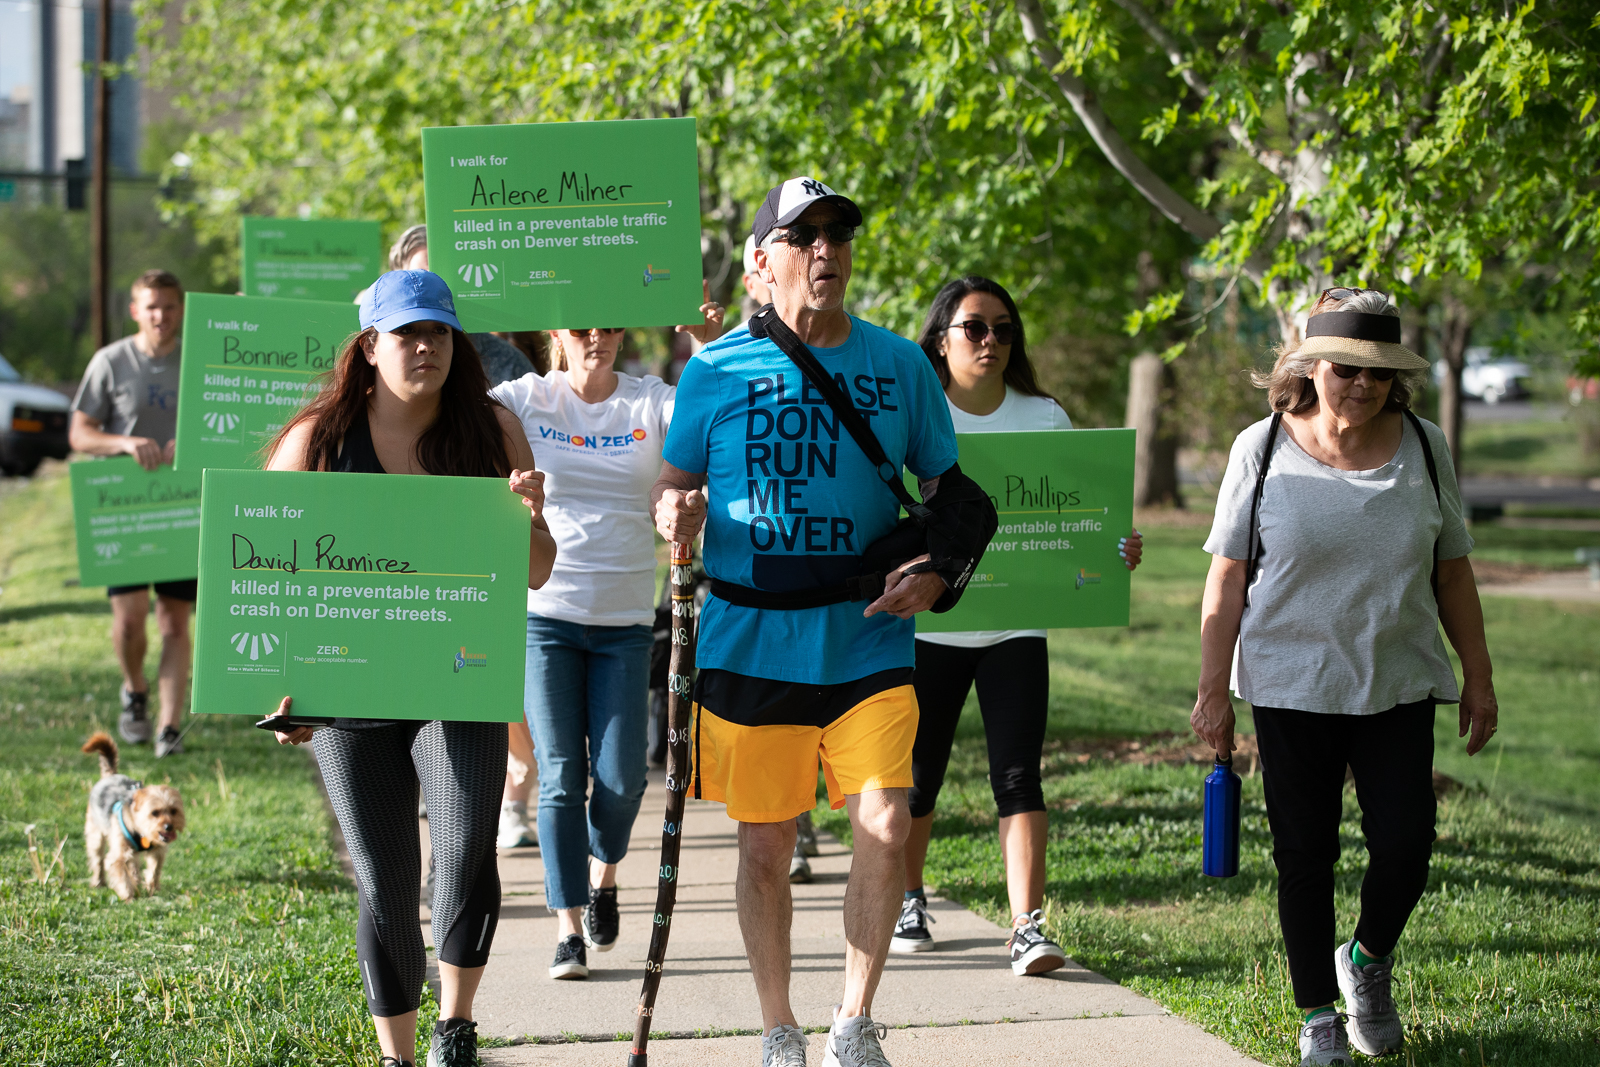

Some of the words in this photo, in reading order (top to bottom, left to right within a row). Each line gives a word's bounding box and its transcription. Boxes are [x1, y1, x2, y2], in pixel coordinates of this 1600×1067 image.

[450, 156, 454, 167] I
[457, 155, 487, 167] walk
[490, 155, 508, 167] for
[471, 174, 549, 206] Arlene
[558, 171, 633, 202] Milner
[801, 180, 827, 196] NY
[454, 219, 494, 233] killed
[498, 218, 512, 231] in
[516, 220, 526, 231] a
[530, 214, 619, 233] preventable
[622, 213, 667, 227] traffic
[454, 236, 497, 251] crash
[501, 237, 520, 249] on
[524, 234, 578, 249] Denver
[582, 232, 639, 247] streets.
[529, 270, 556, 279] ZERO
[207, 319, 212, 329] I
[214, 320, 240, 331] walk
[242, 321, 259, 332] for
[223, 335, 298, 368] Bonnie
[305, 336, 335, 370] Pad
[204, 373, 241, 387] killed
[243, 376, 256, 388] in
[260, 379, 268, 389] a
[203, 391, 241, 402] crash
[244, 394, 261, 404] on
[539, 425, 597, 449] VISION
[601, 428, 647, 447] ZERO
[746, 442, 837, 478] RUN
[747, 479, 808, 514] ME
[1005, 475, 1080, 515] Phillips
[235, 505, 239, 517] I
[243, 505, 278, 518] walk
[282, 506, 304, 519] for
[750, 516, 854, 552] OVER
[997, 521, 1057, 535] ventable
[1061, 519, 1102, 533] traffic
[232, 533, 300, 575] David
[315, 534, 418, 573] Ramirez
[986, 539, 1018, 552] nver
[1021, 537, 1074, 551] streets.
[231, 580, 279, 595] killed
[285, 581, 301, 596] in
[307, 585, 318, 597] a
[323, 583, 430, 602] preventable
[435, 587, 489, 602] traffic
[230, 602, 281, 617] crash
[286, 606, 309, 618] on
[315, 604, 380, 620] Denver
[384, 606, 452, 622] streets.
[316, 645, 349, 655] ZERO
